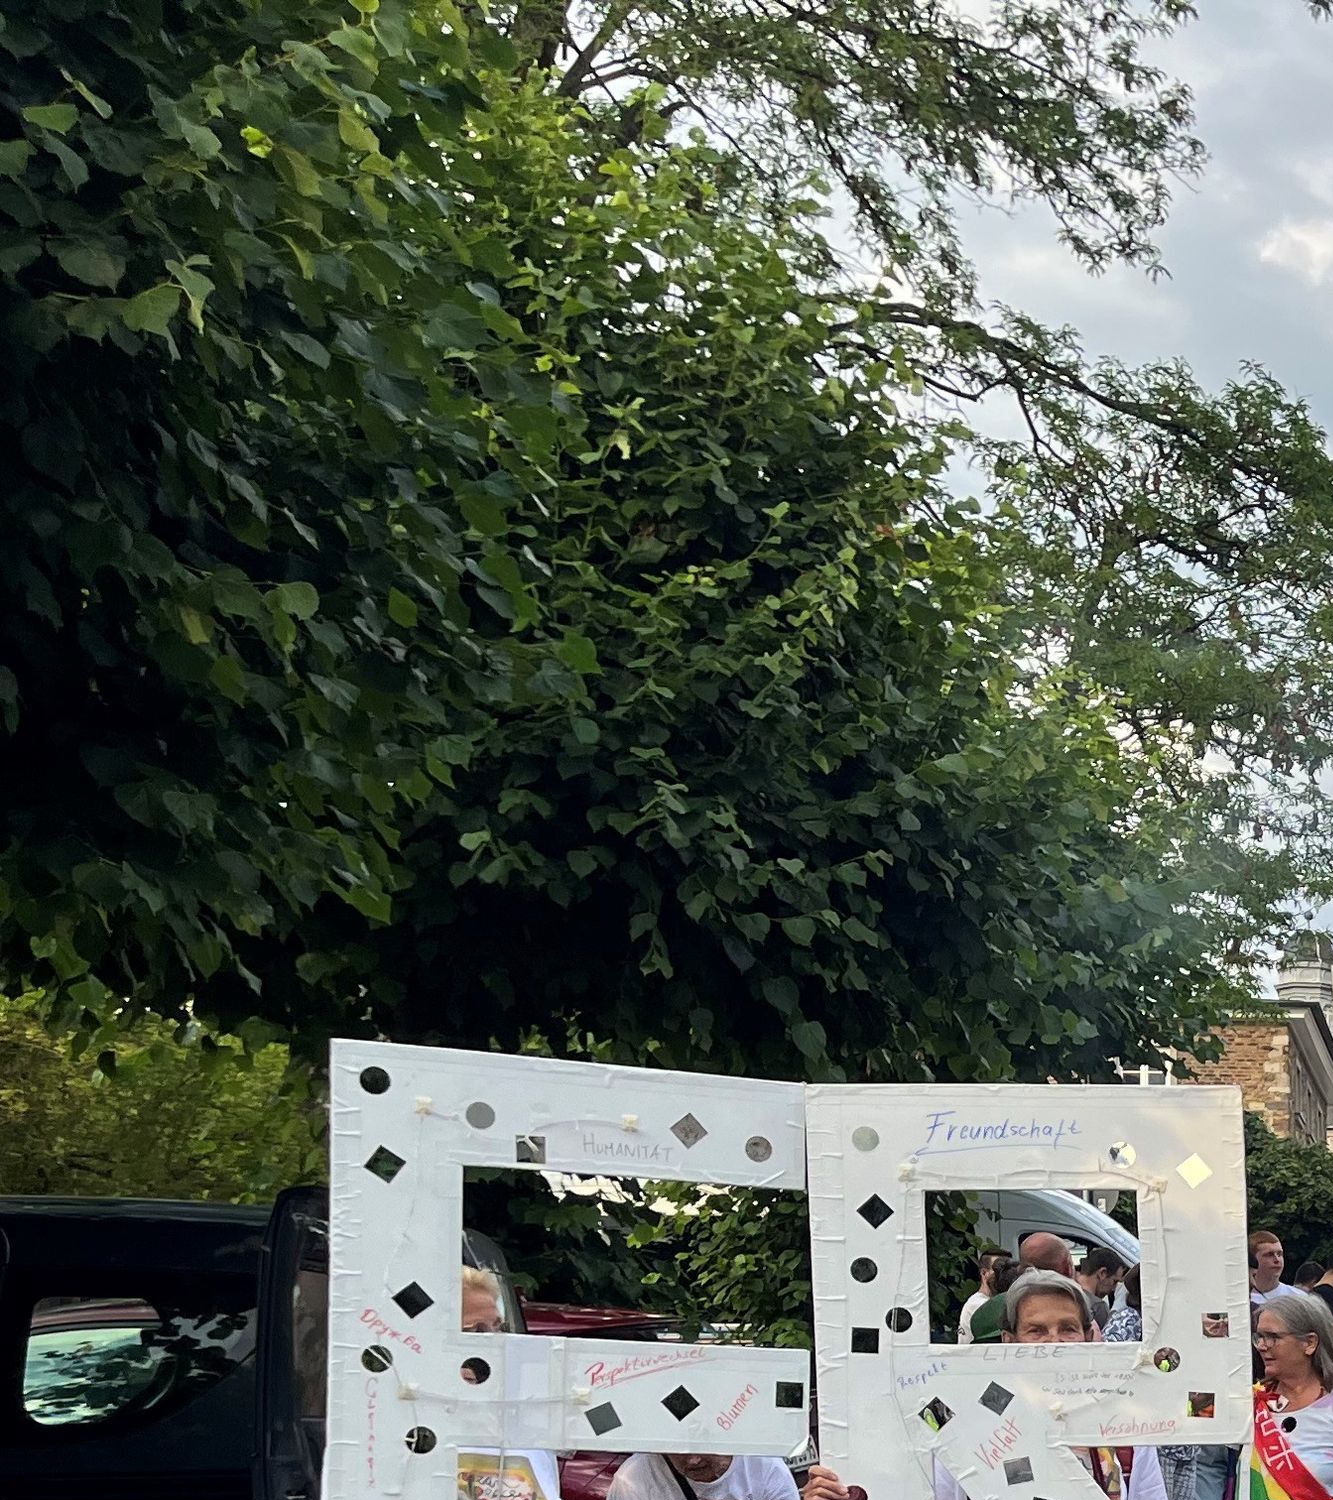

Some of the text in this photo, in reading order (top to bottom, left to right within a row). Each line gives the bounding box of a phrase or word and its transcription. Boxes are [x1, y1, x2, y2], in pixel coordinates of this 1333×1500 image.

[926, 1110, 1083, 1151] Freundschaft
[982, 1344, 1067, 1362] LIEBE
[716, 1382, 760, 1433] Blumen
